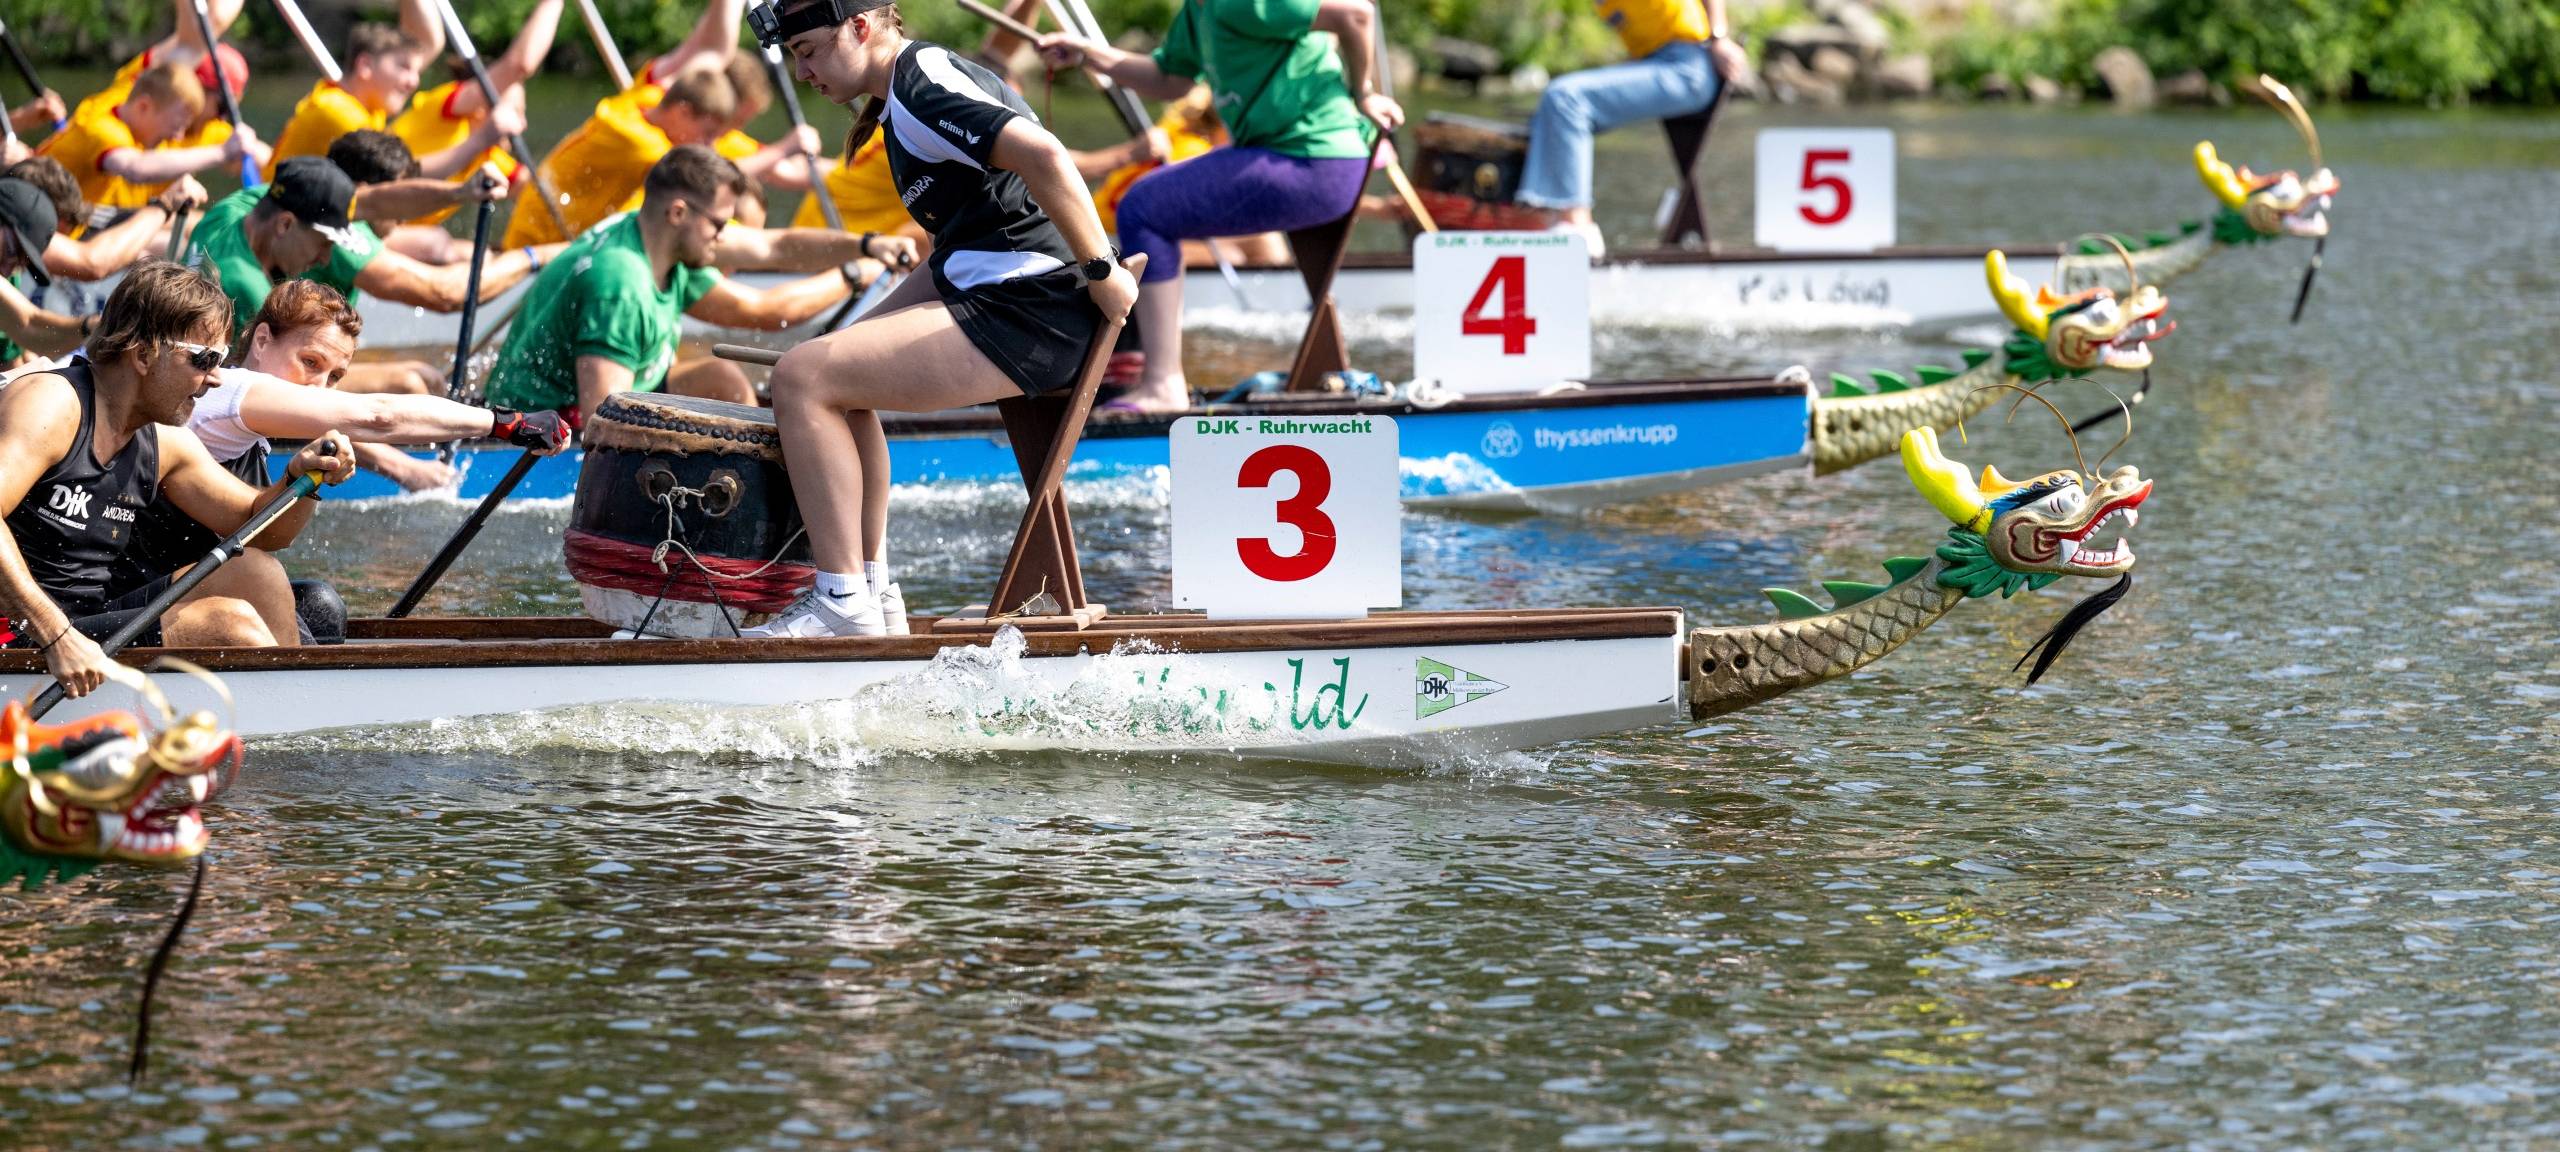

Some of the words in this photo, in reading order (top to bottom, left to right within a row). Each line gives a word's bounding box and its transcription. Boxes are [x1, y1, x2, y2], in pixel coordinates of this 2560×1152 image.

[938, 119, 965, 138] erima
[1799, 150, 1853, 226] 5
[1462, 256, 1537, 354] 4
[1197, 420, 1240, 434] DJK
[1259, 419, 1372, 434] Ruhrwacht
[1534, 424, 1678, 452] thyssenkrupp
[101, 504, 136, 523] ANDREAS
[1236, 444, 1337, 582] 3
[1423, 677, 1449, 698] DJK
